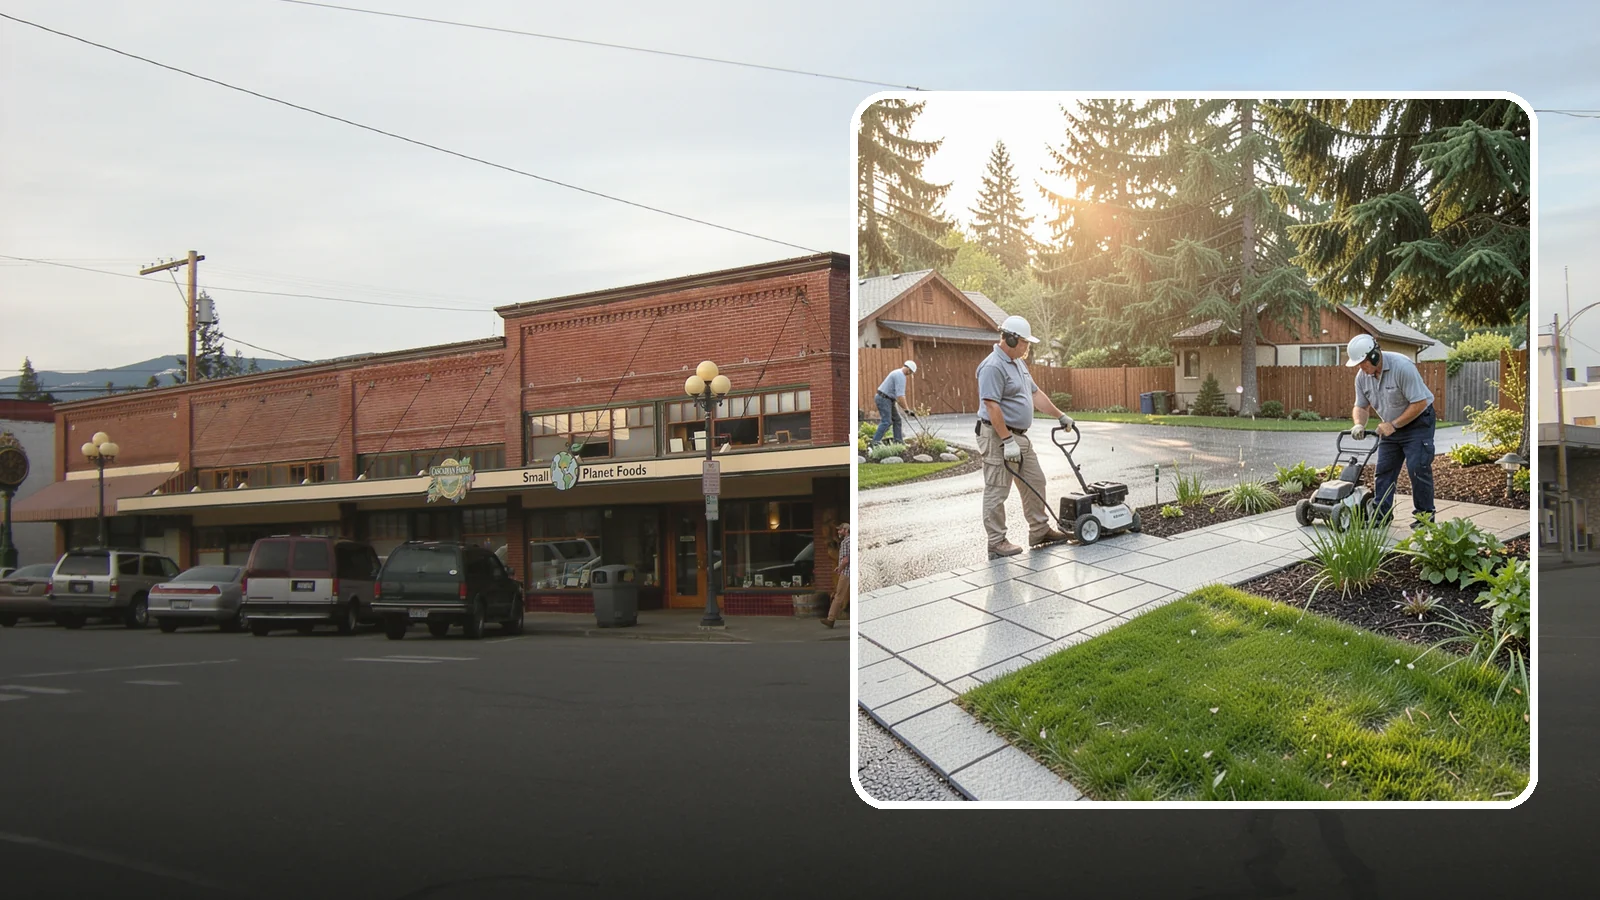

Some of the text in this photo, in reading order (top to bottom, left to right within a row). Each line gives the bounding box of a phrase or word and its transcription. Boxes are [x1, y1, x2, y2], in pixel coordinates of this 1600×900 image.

[523, 464, 647, 483] Small Planet Foods
